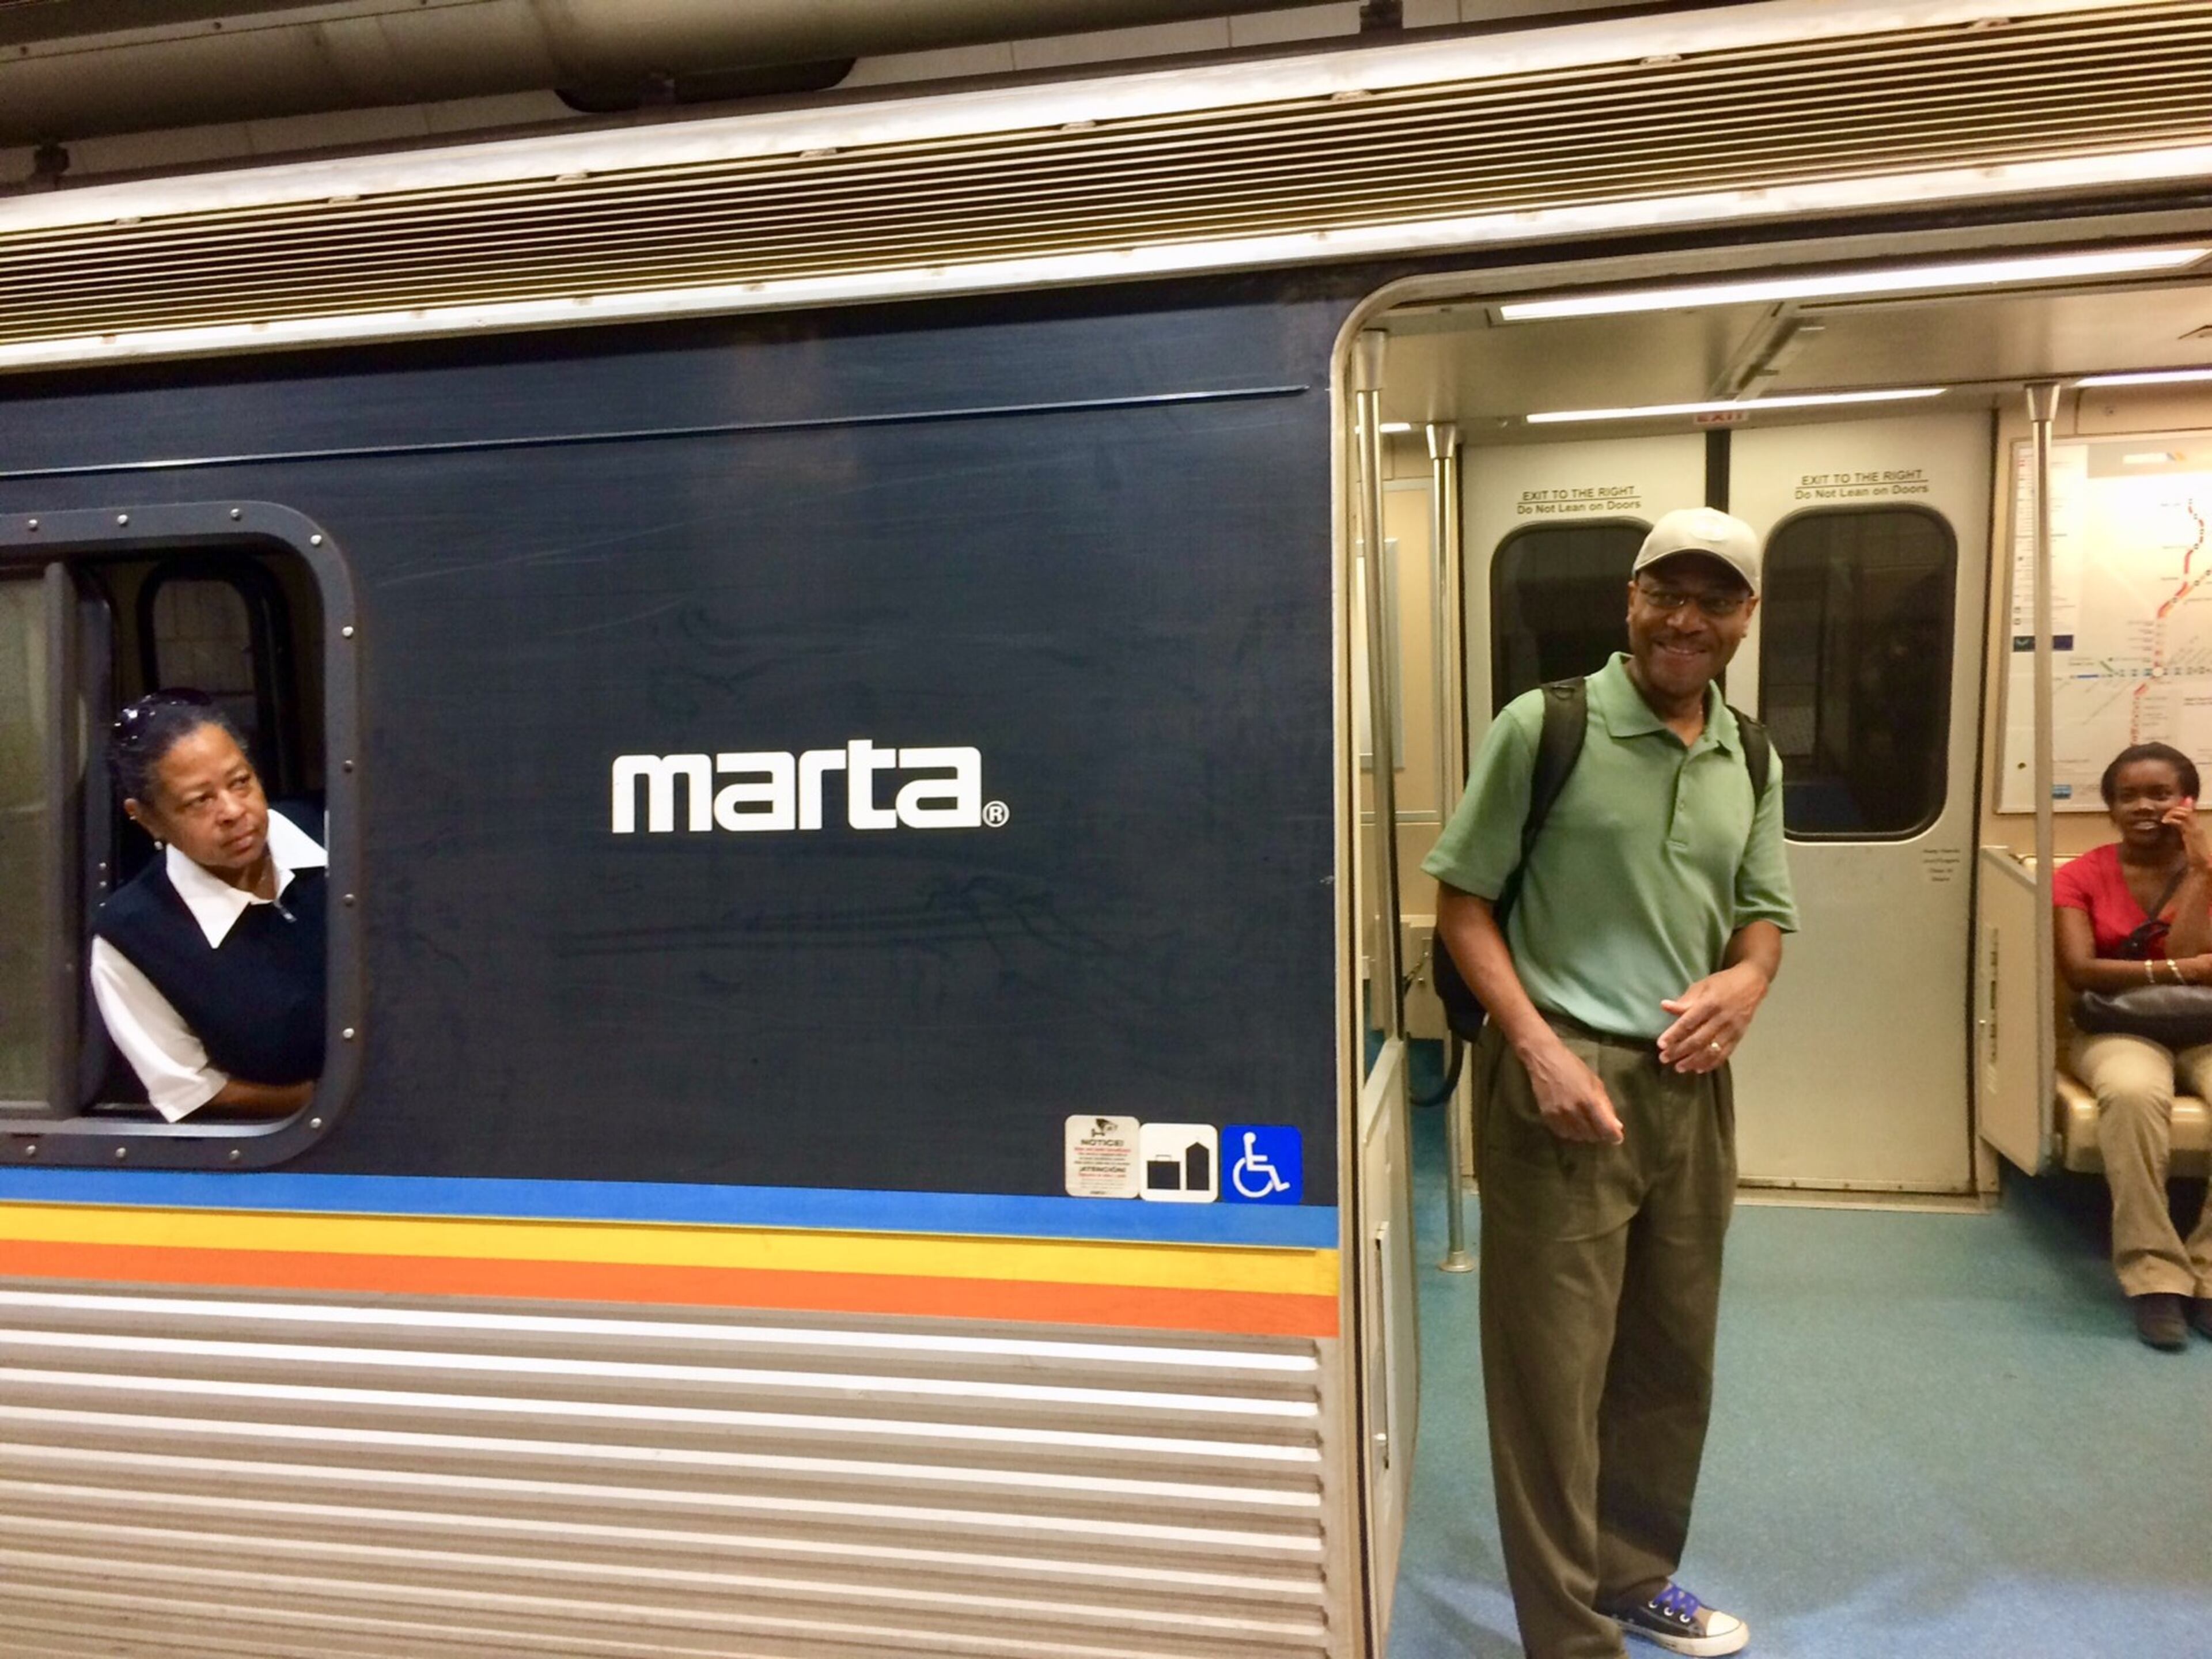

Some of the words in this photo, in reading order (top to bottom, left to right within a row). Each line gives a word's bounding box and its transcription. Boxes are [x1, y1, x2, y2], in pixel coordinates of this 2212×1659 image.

[1696, 411, 1744, 422] EXIT
[1801, 475, 1830, 485] EXIT
[1834, 474, 1850, 483] TO
[1855, 472, 1878, 482] THE
[1883, 469, 1922, 480] RIGHT
[1522, 490, 1548, 501] EXIT
[1552, 490, 1568, 499] TO
[1571, 488, 1594, 498] THE
[1599, 486, 1635, 496] RIGHT
[1795, 490, 1811, 499] Do
[1815, 489, 1836, 498] Not
[1840, 488, 1869, 497] Lean
[1873, 487, 1889, 495] on
[1892, 484, 1928, 494] Doors
[1517, 505, 1533, 514] Do
[1536, 504, 1555, 513] Not
[1559, 503, 1585, 513] Lean
[1589, 503, 1604, 511] on
[1607, 501, 1641, 510] Doors
